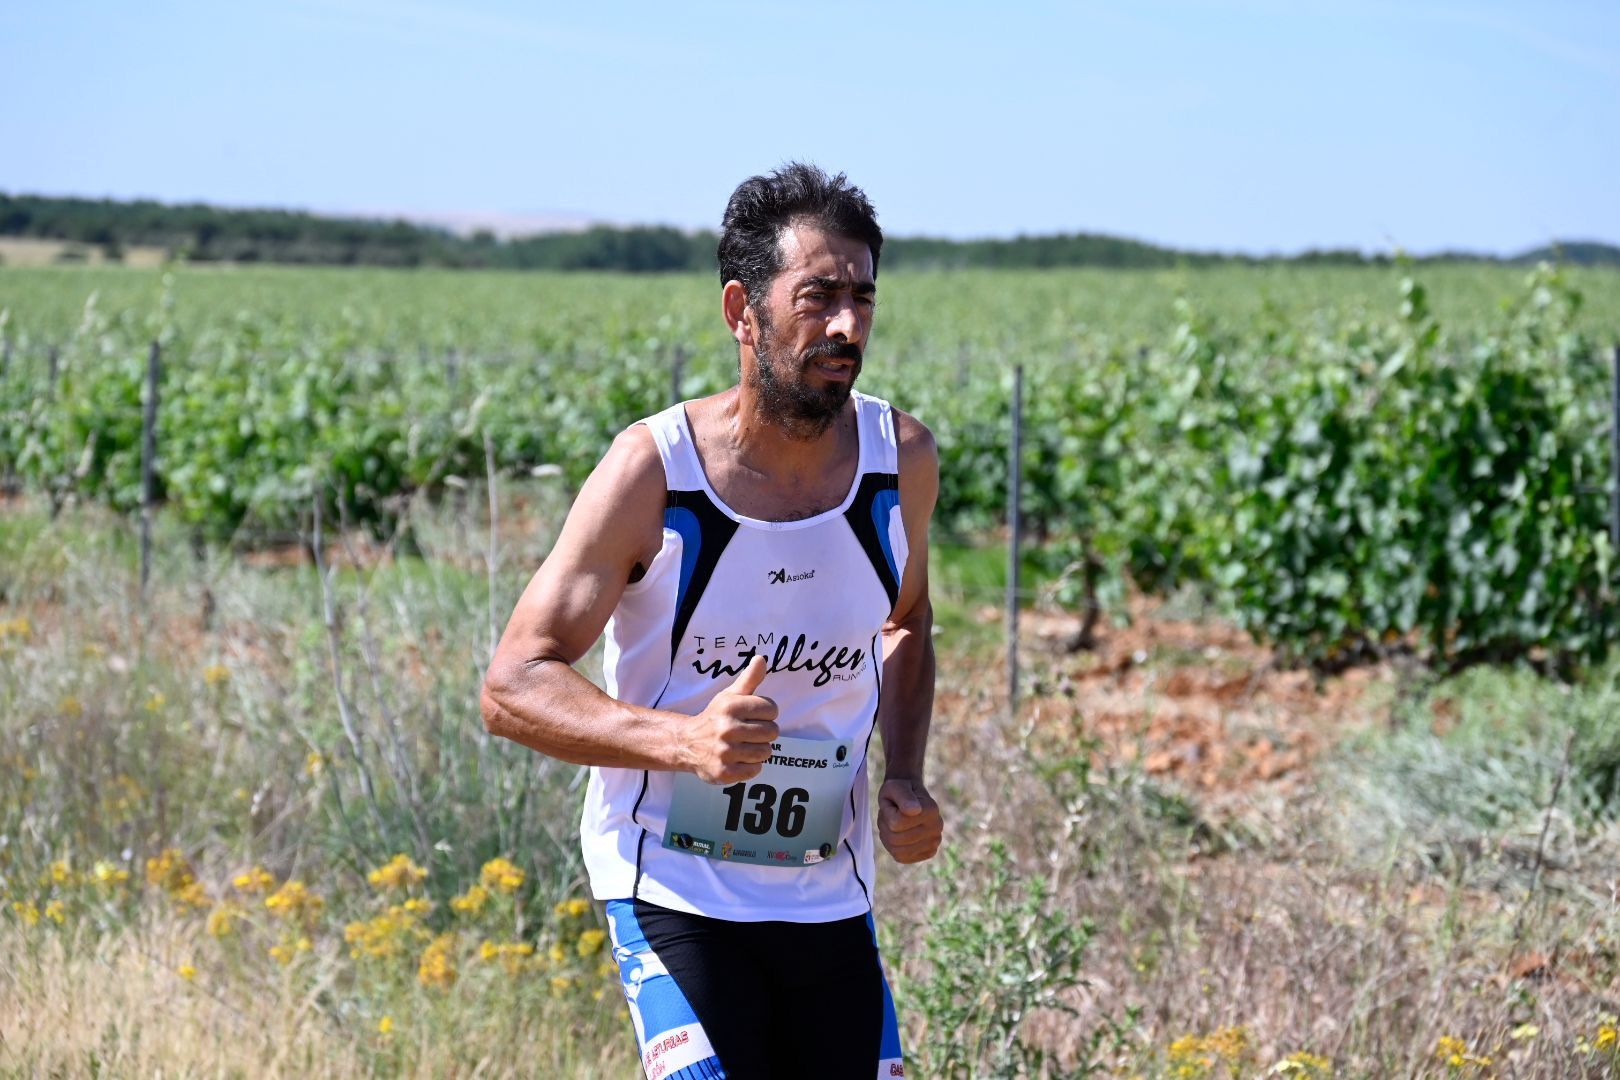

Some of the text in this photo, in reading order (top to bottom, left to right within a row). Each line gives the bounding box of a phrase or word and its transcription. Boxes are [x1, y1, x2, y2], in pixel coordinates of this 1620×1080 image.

[693, 632, 774, 649] TEAM
[761, 754, 828, 769] NTRECEPAS
[722, 782, 810, 838] 136
